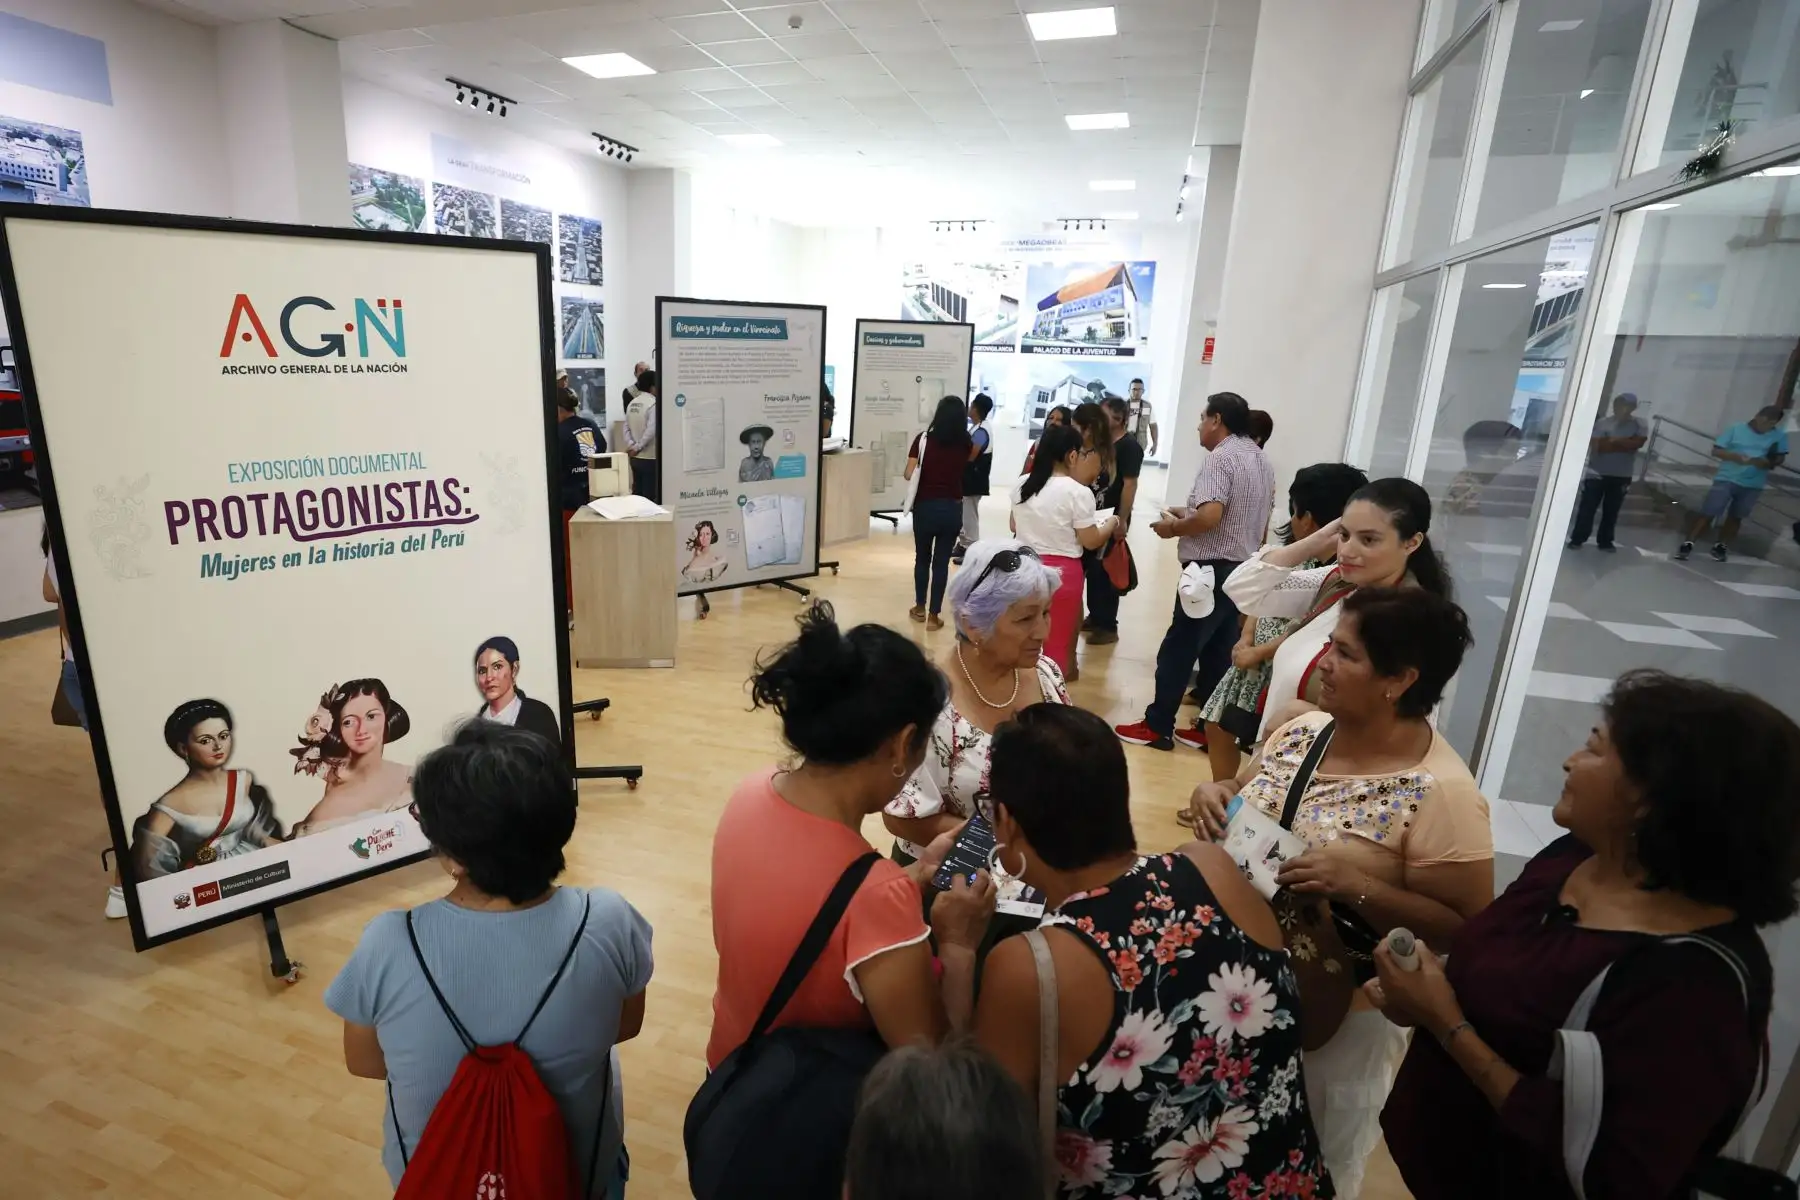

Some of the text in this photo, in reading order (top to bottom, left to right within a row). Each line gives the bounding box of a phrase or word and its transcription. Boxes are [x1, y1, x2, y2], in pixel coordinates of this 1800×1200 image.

[219, 293, 407, 358] AGN
[675, 321, 705, 335] Riqueza
[705, 325, 711, 335] y
[711, 321, 732, 335] poder
[742, 322, 749, 333] el
[750, 323, 782, 335] Virreinato
[1032, 346, 1117, 356] PALACIO DE LA JUVENTUD
[221, 361, 408, 375] ARCHIVO GENERAL DE LA NACIÓN
[227, 451, 427, 483] EXPOSICIÓN DOCUMENTAL
[163, 477, 474, 545] PROTAGONISTAS:
[200, 528, 465, 580] Mujeres en la historia del Perú
[197, 868, 286, 900] PERÚ Ministerio de Cultura
